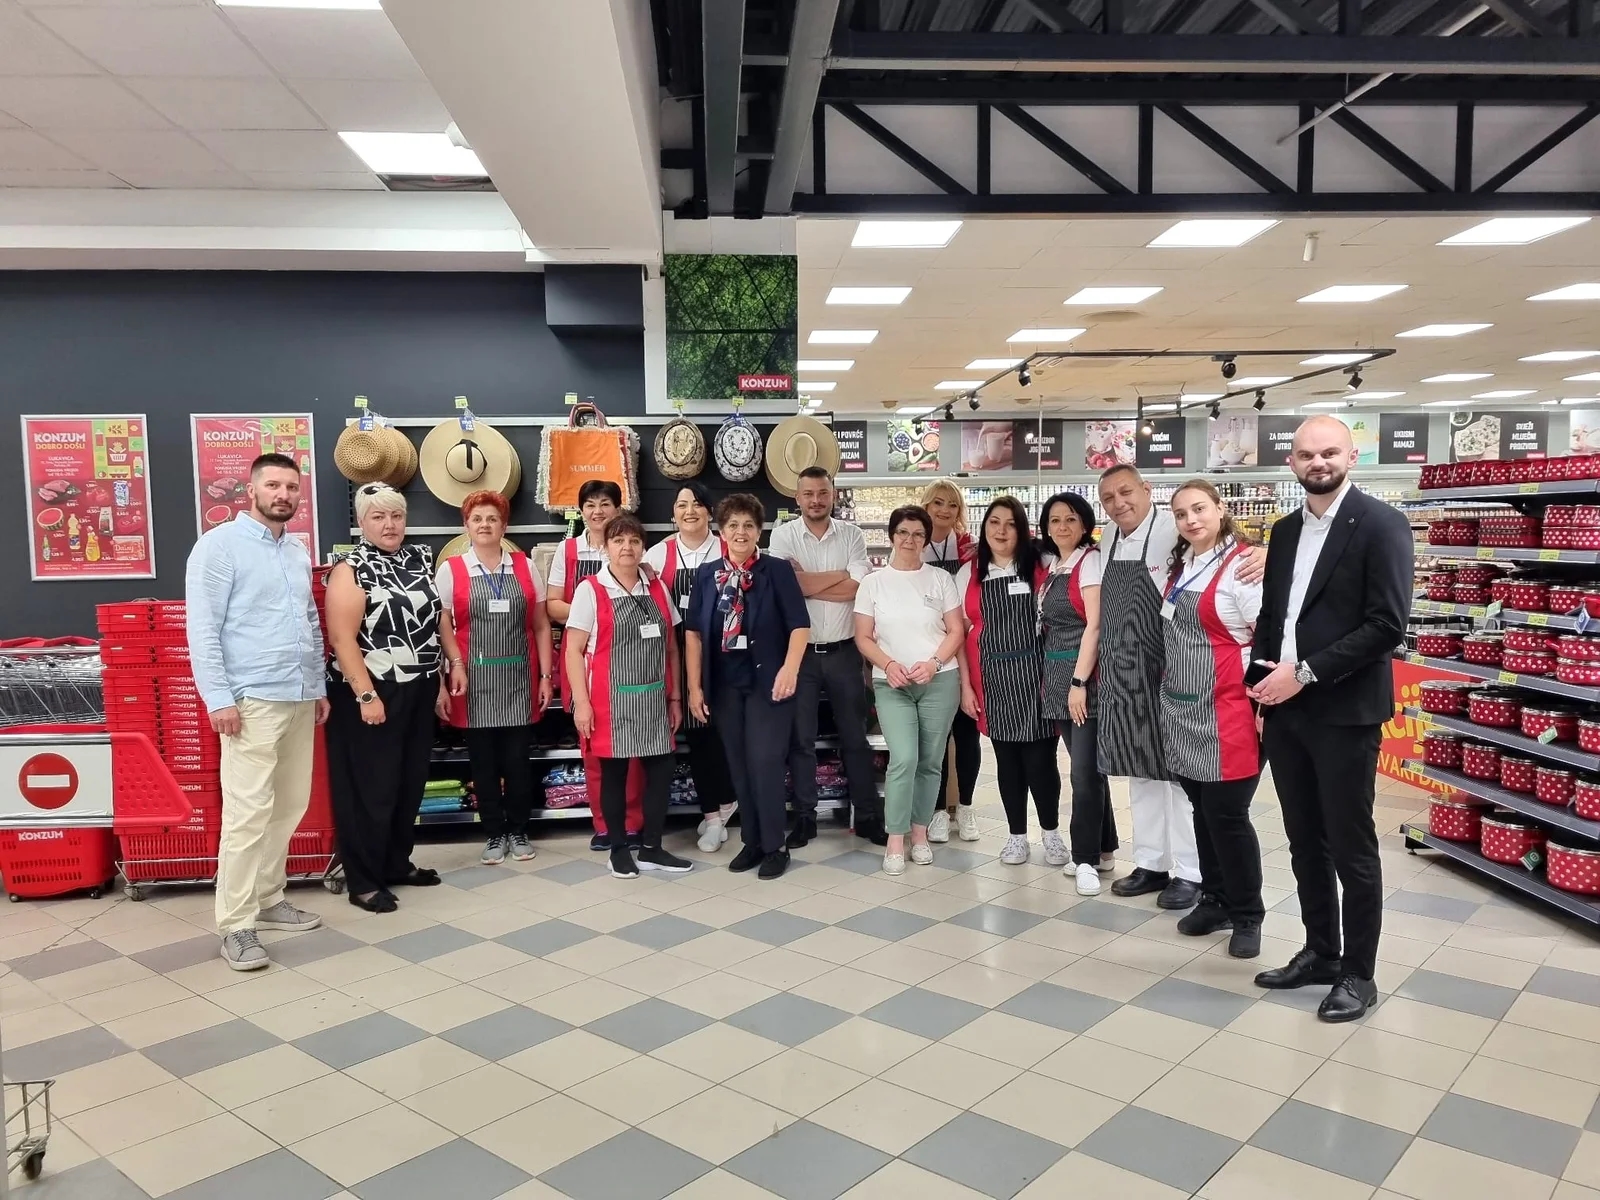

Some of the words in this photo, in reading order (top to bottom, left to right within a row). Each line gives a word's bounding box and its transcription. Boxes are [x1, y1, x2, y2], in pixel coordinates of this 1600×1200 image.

[741, 378, 788, 388] KONZUM
[34, 432, 86, 443] KONZUM
[203, 431, 255, 441] KONZUM
[841, 429, 864, 439] POVRĆE
[1269, 432, 1277, 440] ZA
[64, 442, 86, 450] DOŠLI
[233, 440, 254, 448] DOŠLI
[1149, 444, 1172, 452] JOGURTI
[1274, 442, 1291, 450] JUTRO
[570, 464, 606, 472] SUMMER
[18, 830, 64, 841] KONZUM
